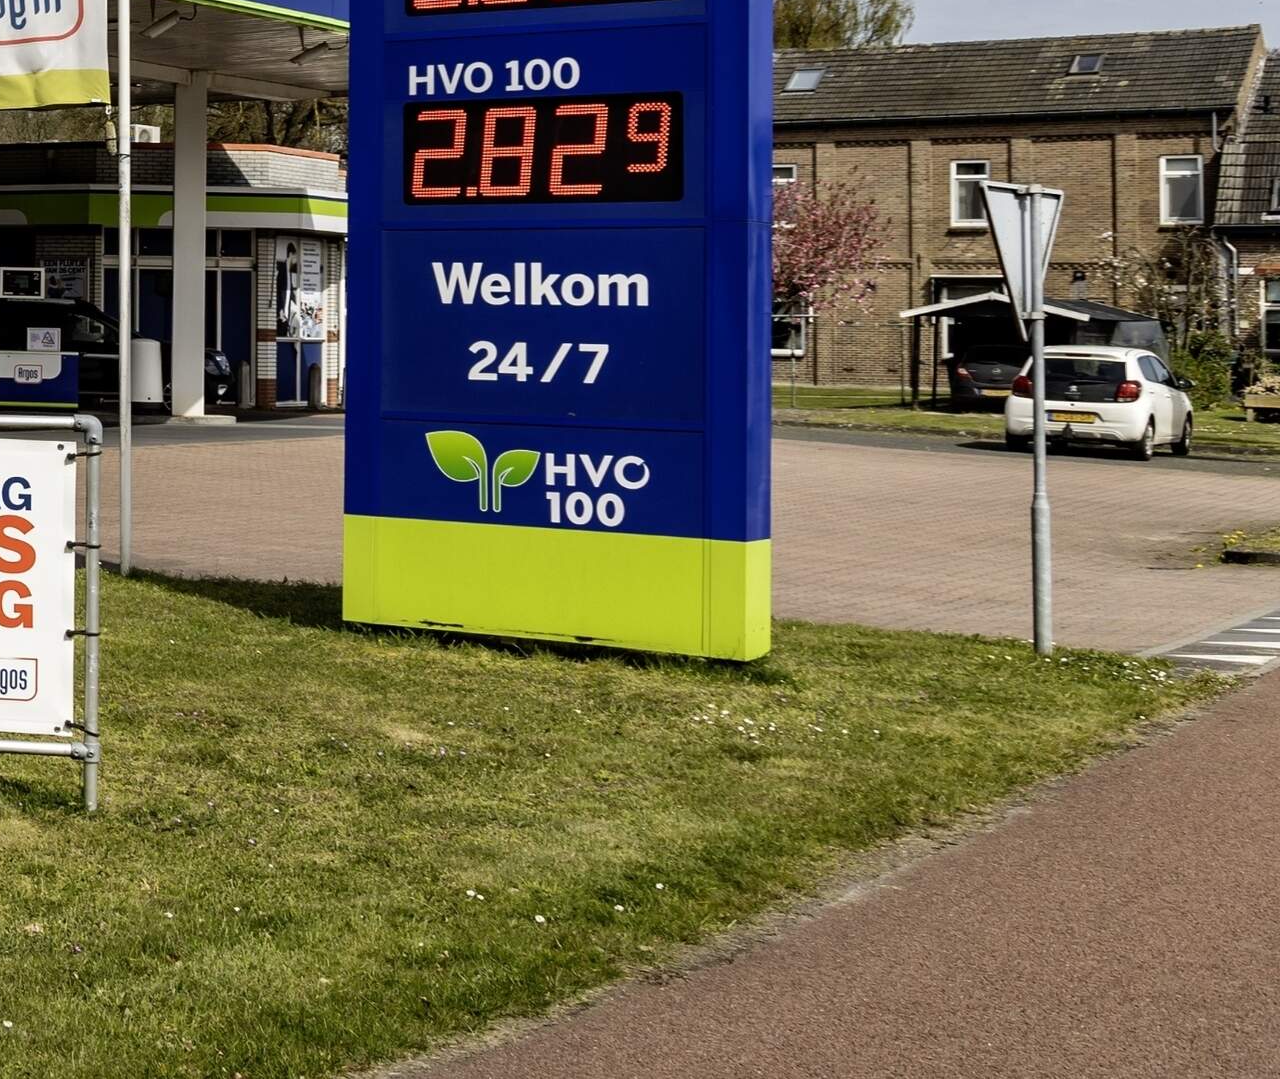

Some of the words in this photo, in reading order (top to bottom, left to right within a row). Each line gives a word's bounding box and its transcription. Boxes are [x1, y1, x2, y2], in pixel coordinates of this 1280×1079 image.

[408, 61, 494, 96] HVO
[505, 57, 581, 92] 100
[431, 262, 650, 307] Welkom
[18, 366, 39, 381] Argos
[545, 452, 650, 490] HVO
[545, 491, 625, 527] 100
